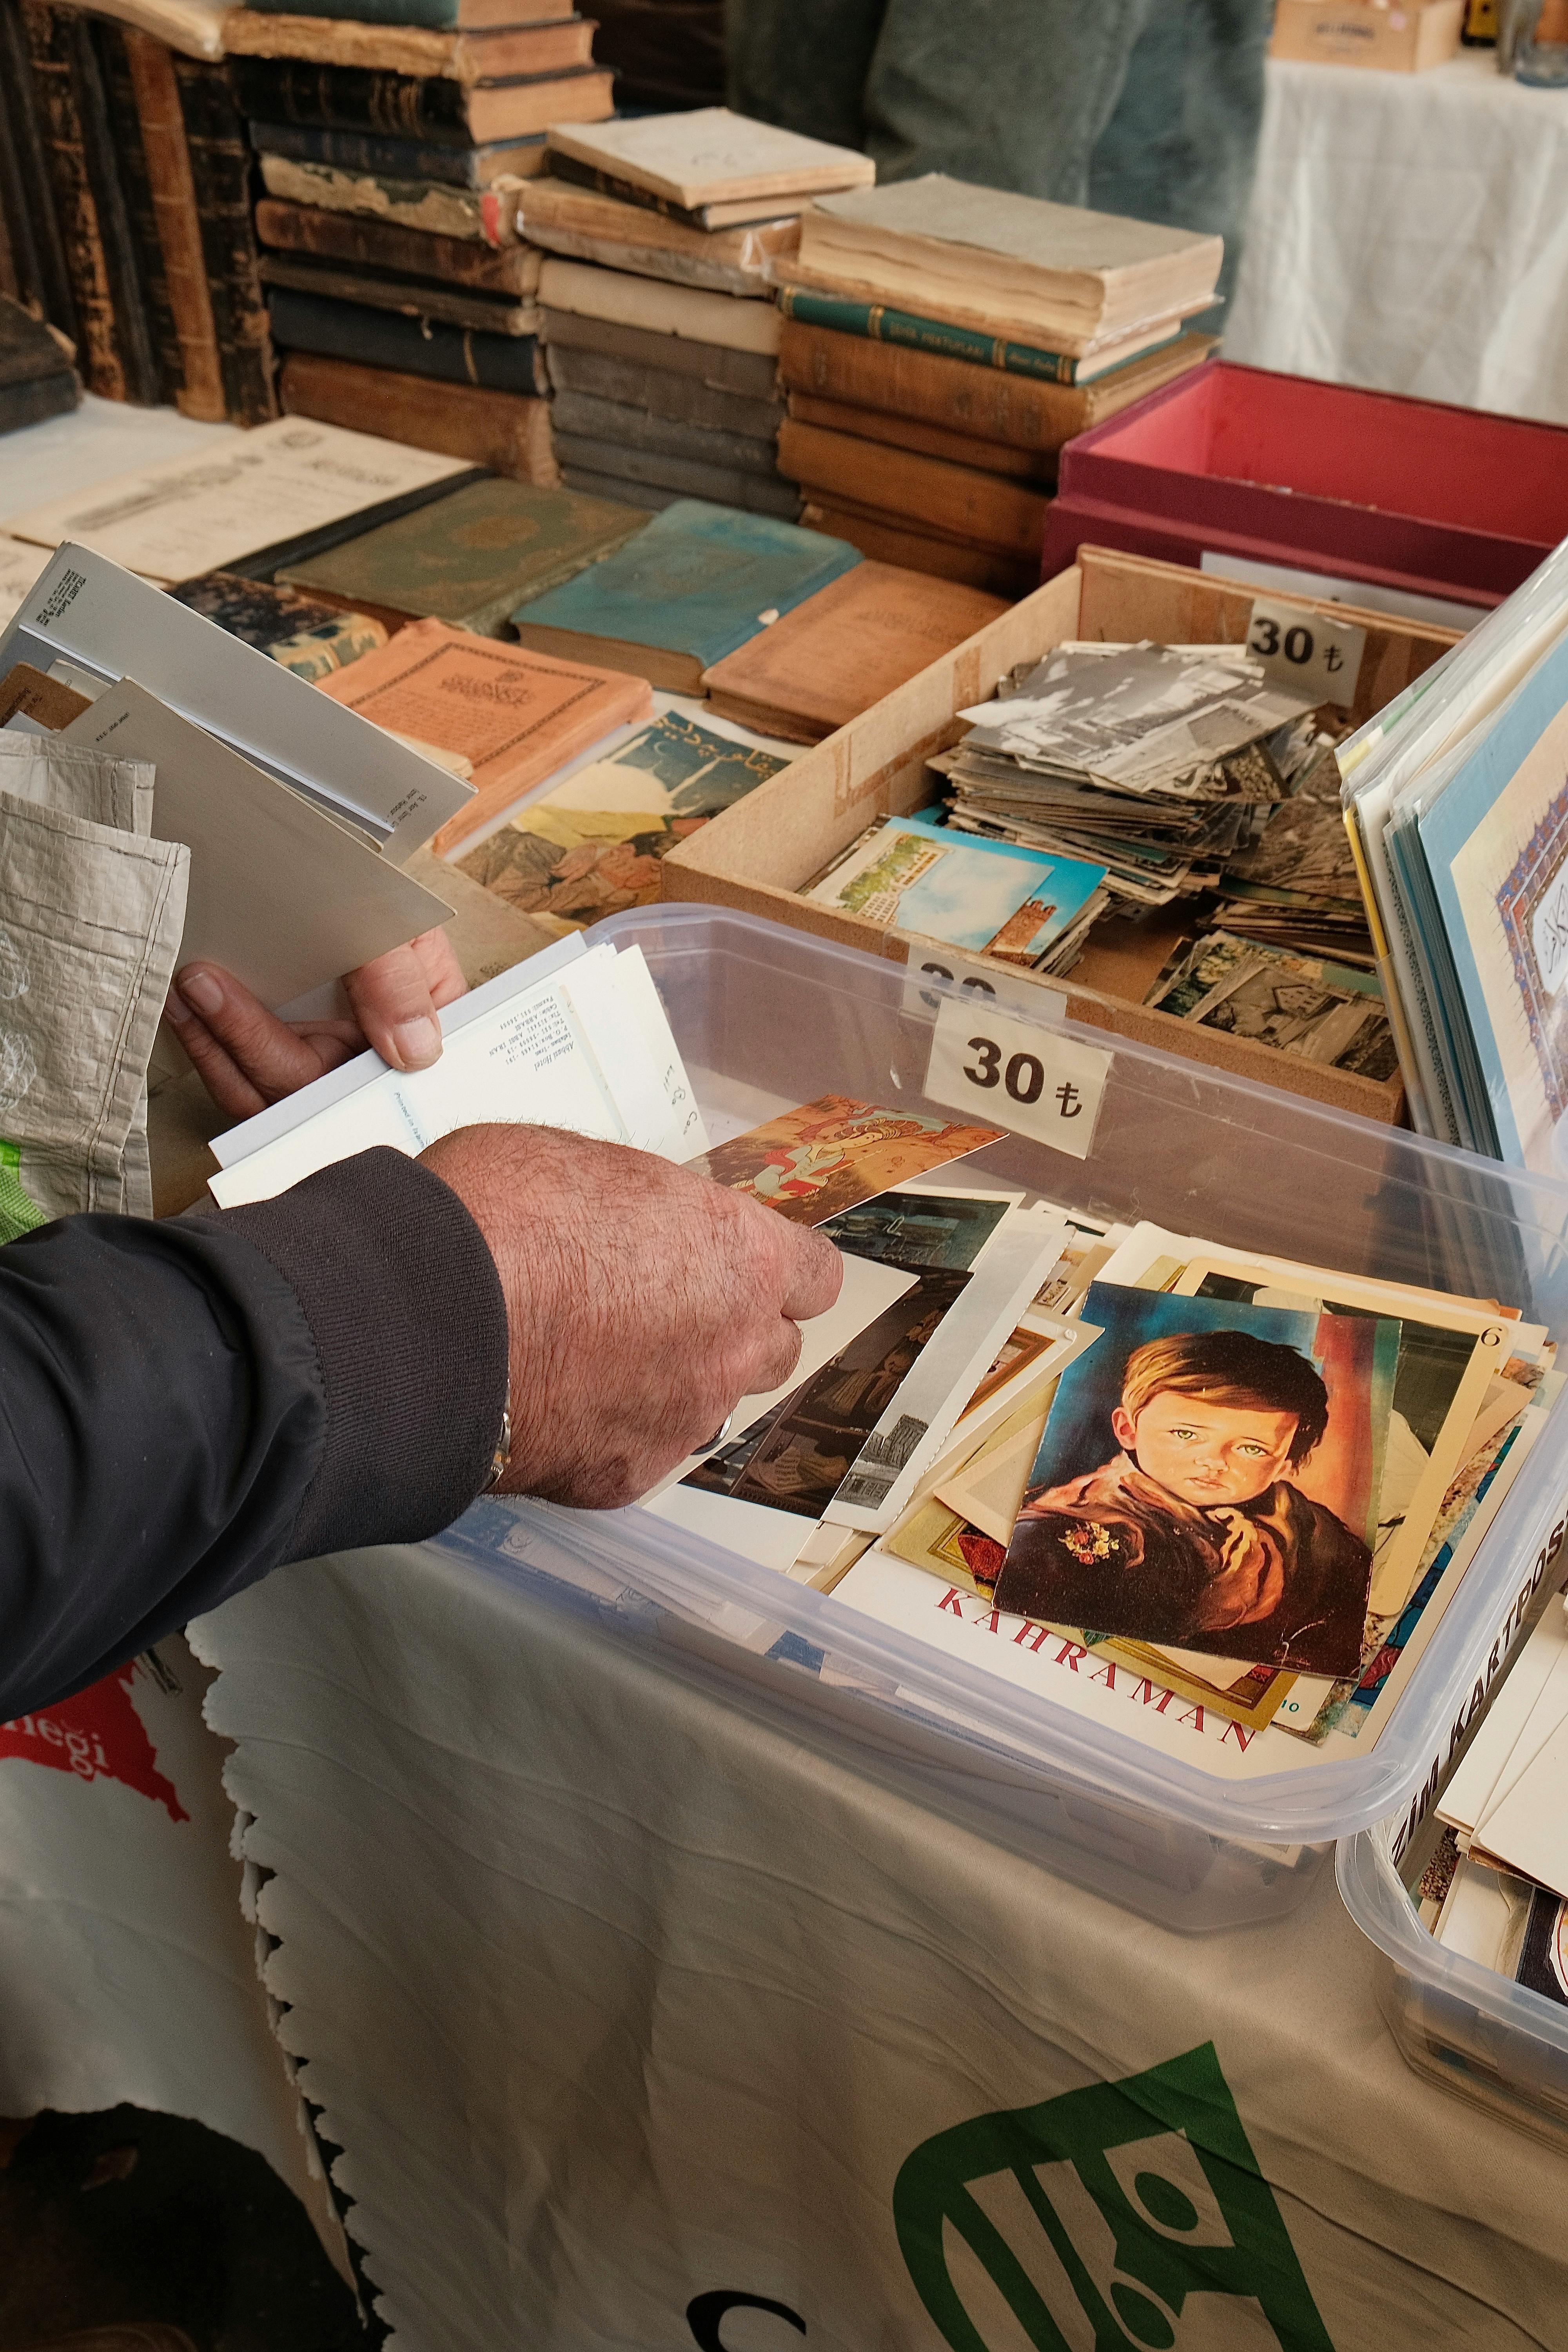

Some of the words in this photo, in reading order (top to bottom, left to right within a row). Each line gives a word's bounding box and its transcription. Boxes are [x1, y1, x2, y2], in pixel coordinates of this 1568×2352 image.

[1251, 616, 1313, 664] 30
[534, 1054, 552, 1071] Hotel
[963, 1036, 1045, 1104] 30
[1481, 1327, 1502, 1347] 6
[1449, 1509, 1568, 1764] KARTPOS
[934, 1586, 1256, 1753] KAHRAMAN
